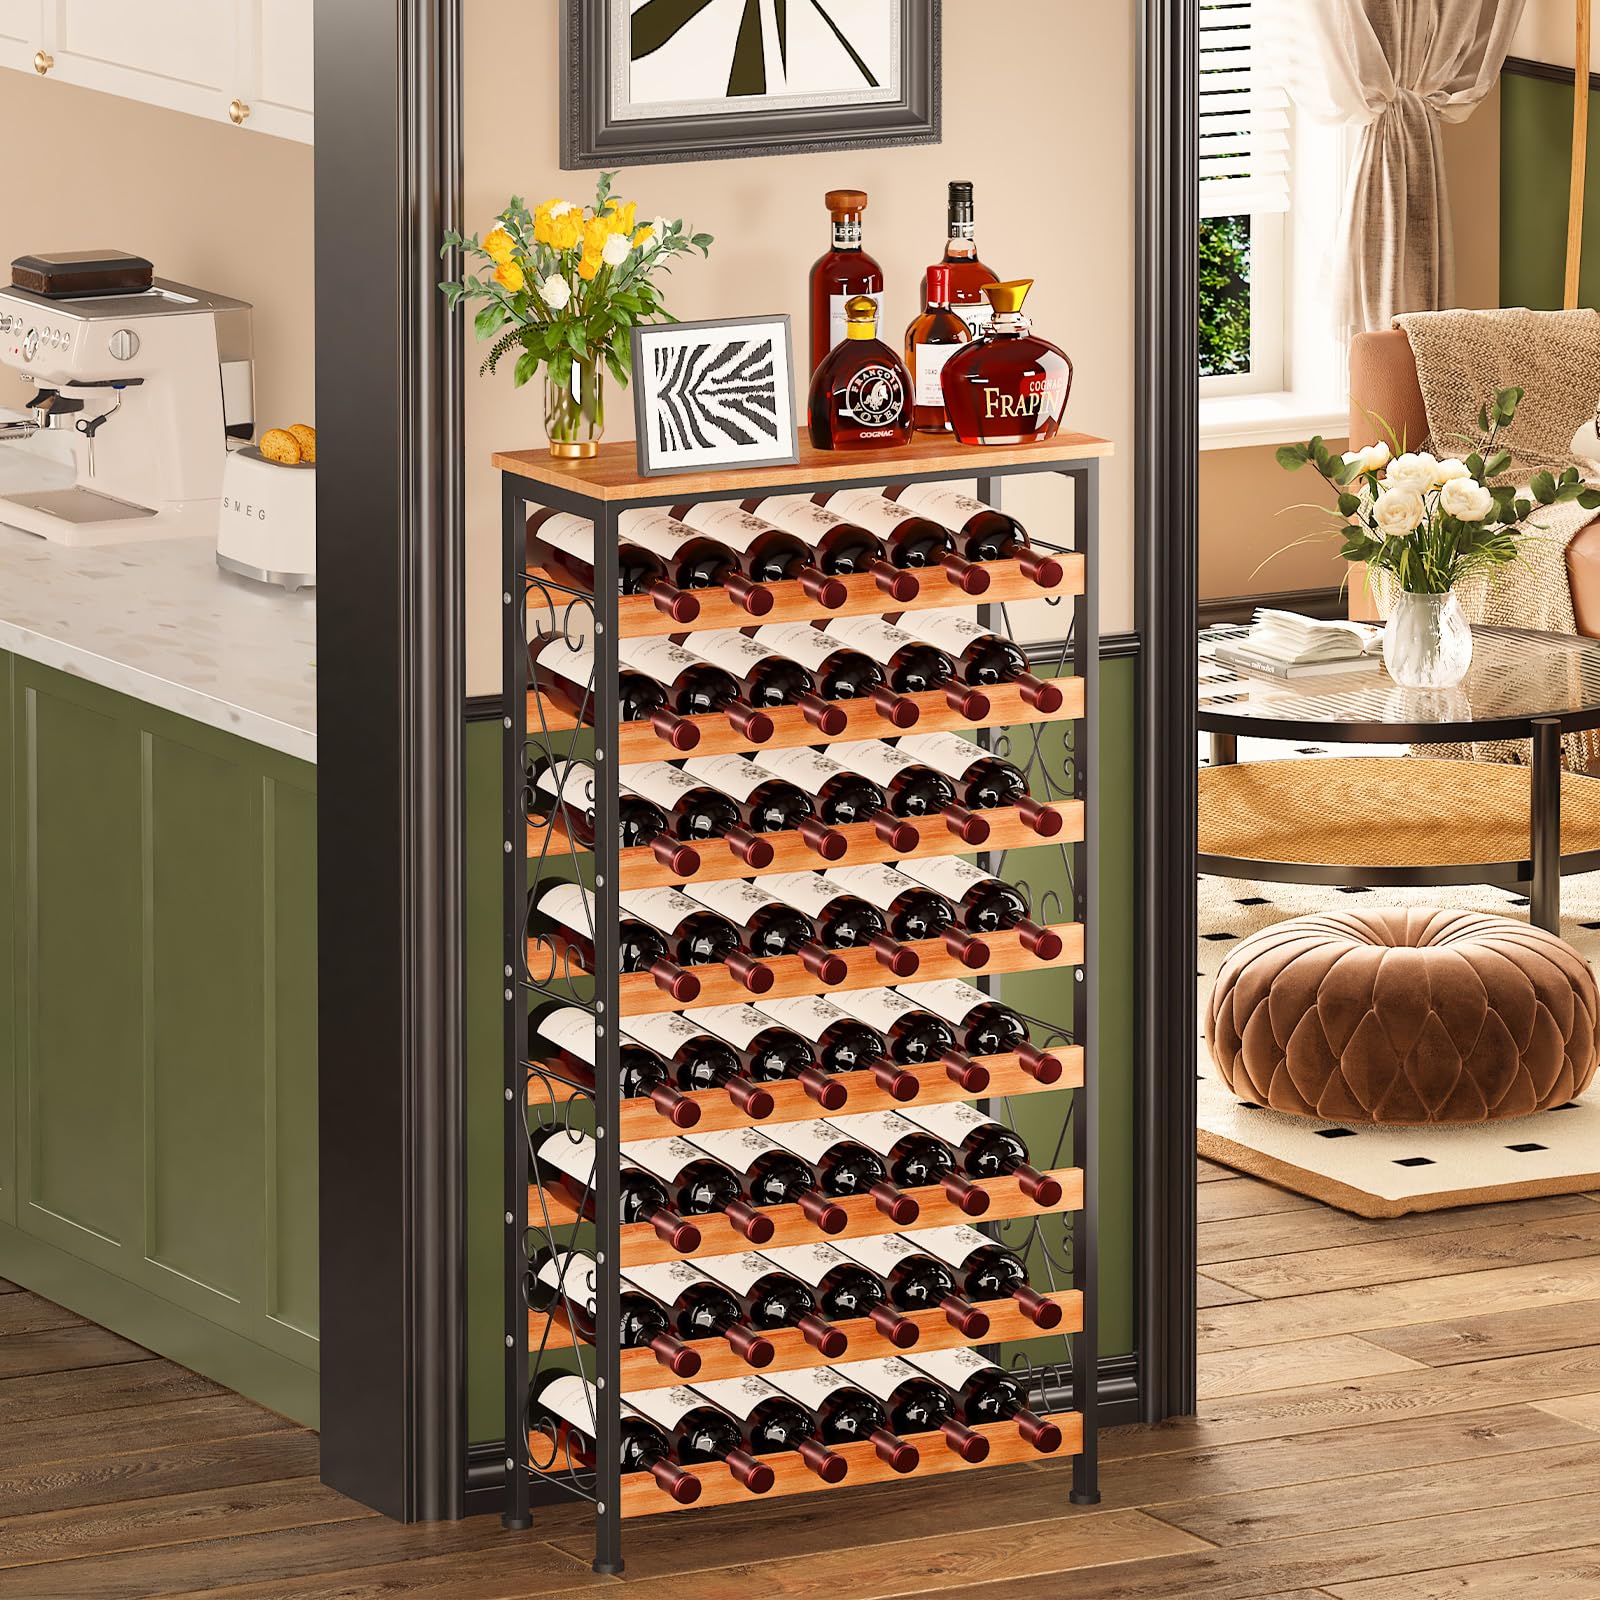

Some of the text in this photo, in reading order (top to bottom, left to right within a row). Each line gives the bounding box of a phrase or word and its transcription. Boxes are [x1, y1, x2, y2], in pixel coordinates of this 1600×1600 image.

[851, 369, 899, 393] FRANÇOIS
[1029, 377, 1063, 392] COGNAC
[853, 402, 901, 423] VOYER
[860, 430, 894, 438] COGNAC
